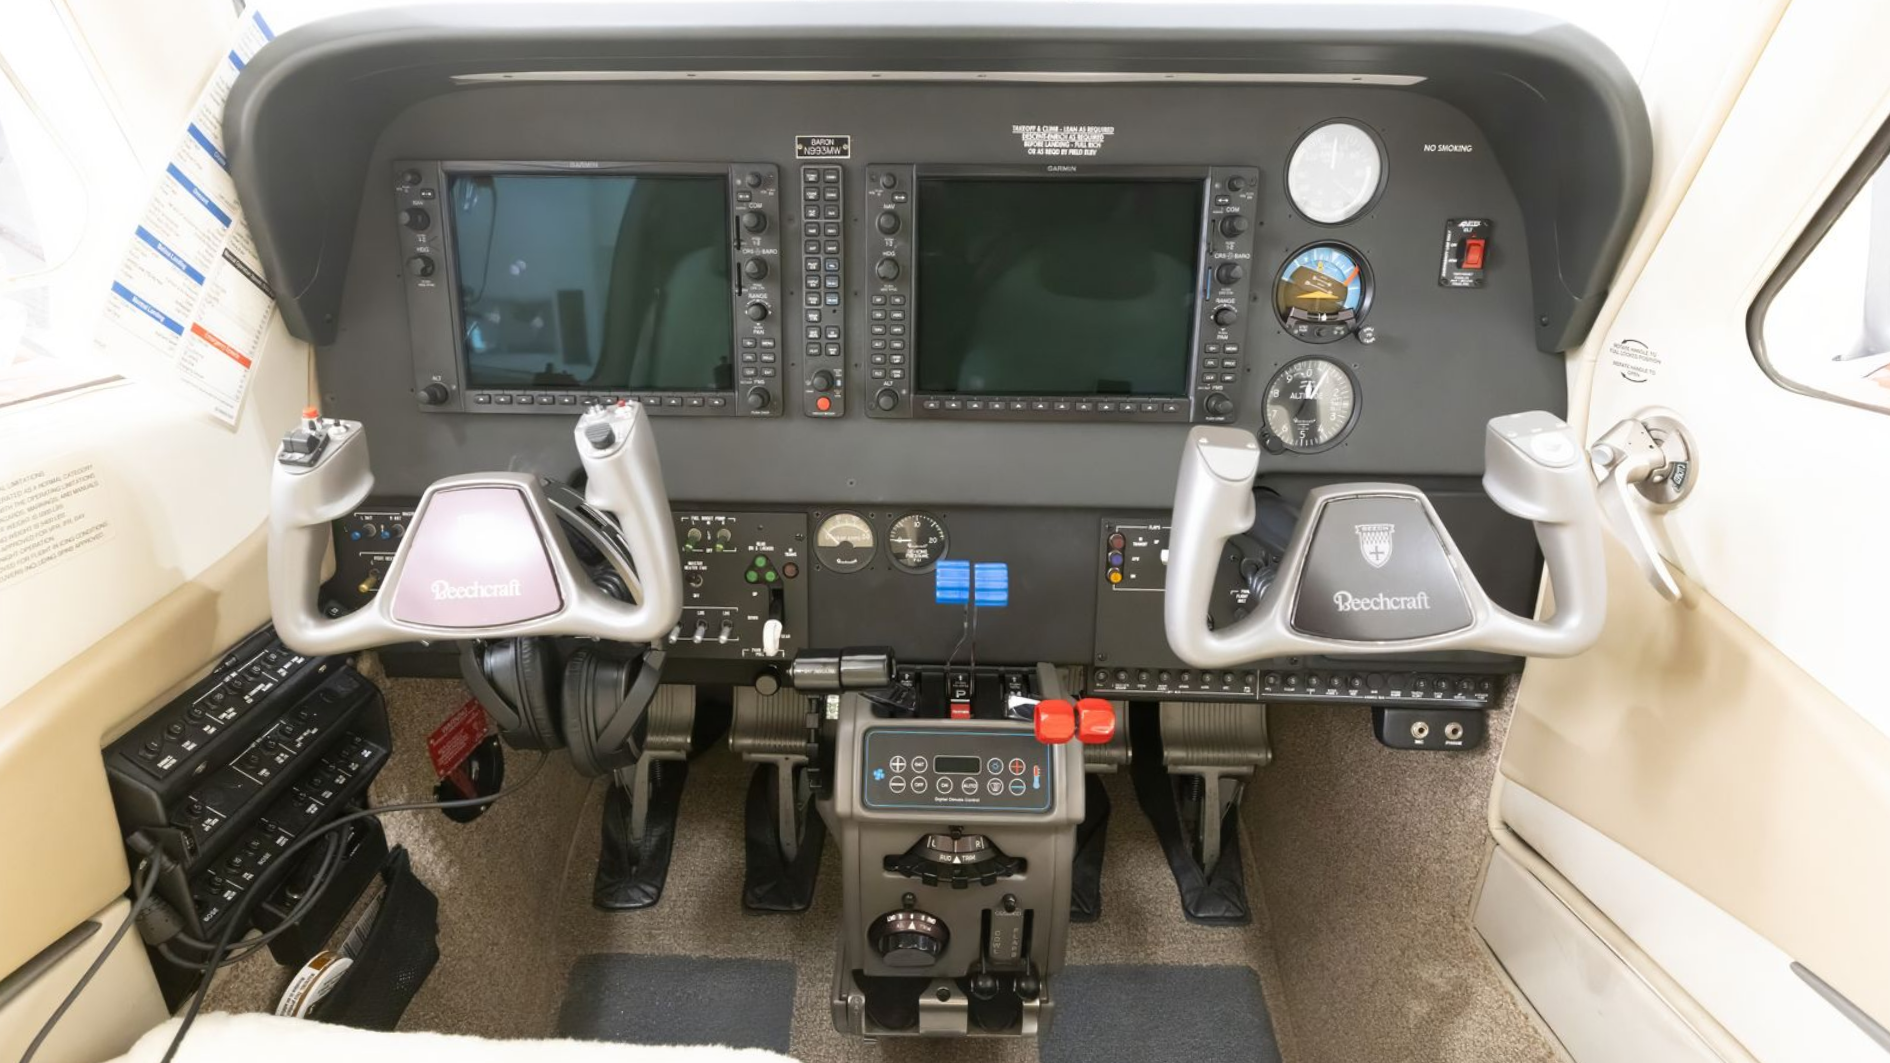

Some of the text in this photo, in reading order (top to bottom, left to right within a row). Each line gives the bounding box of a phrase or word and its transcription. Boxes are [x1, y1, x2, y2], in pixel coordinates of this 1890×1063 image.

[1631, 347, 1649, 356] HANDLE
[1639, 355, 1661, 364] POSITION
[1631, 365, 1648, 374] HANDLE
[1286, 375, 1293, 383] 9
[1273, 389, 1280, 398] 8
[1333, 388, 1339, 396] 2
[1272, 410, 1278, 418] 7
[1300, 430, 1306, 438] 5
[38, 476, 61, 488] NORMAL
[63, 464, 93, 479] CATEGORY
[27, 485, 61, 502] OPERATING
[62, 473, 95, 489] LIMITATIONS
[35, 529, 48, 537] FOR
[74, 513, 85, 522] DAY
[19, 537, 54, 554] OPERATION
[17, 556, 30, 565] FOR
[431, 579, 521, 600] Beechcraft
[1333, 590, 1430, 612] Beechcraft
[932, 839, 936, 848] L
[203, 907, 219, 922] BOSE
